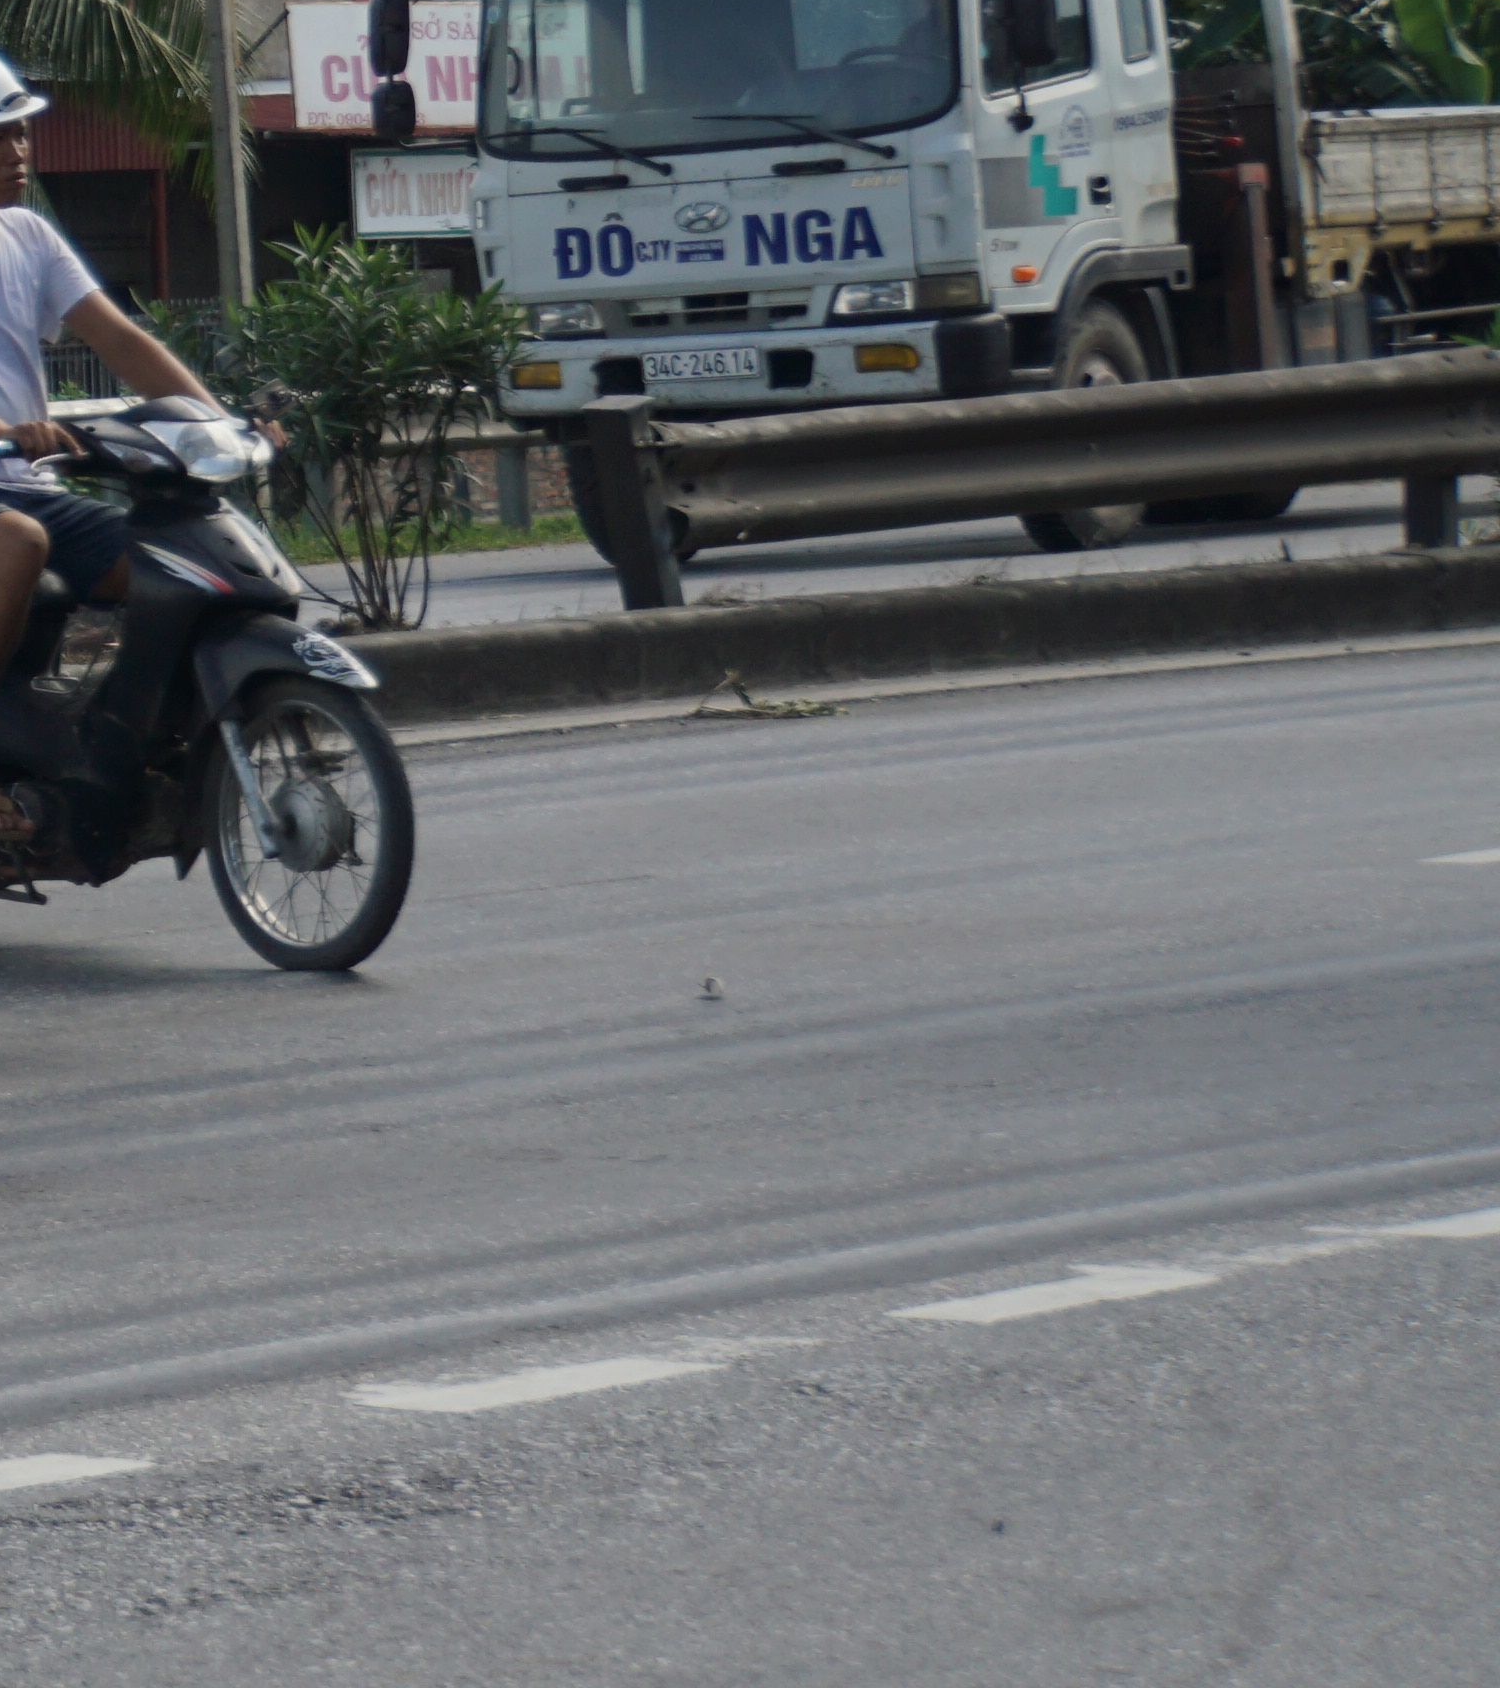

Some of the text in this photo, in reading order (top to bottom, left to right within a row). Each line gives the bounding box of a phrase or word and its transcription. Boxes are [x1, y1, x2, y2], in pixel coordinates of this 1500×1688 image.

[448, 12, 476, 40] SẢ
[553, 212, 635, 280] ĐÔ
[742, 206, 885, 267] NGA
[644, 346, 756, 379] 34C-246.14
